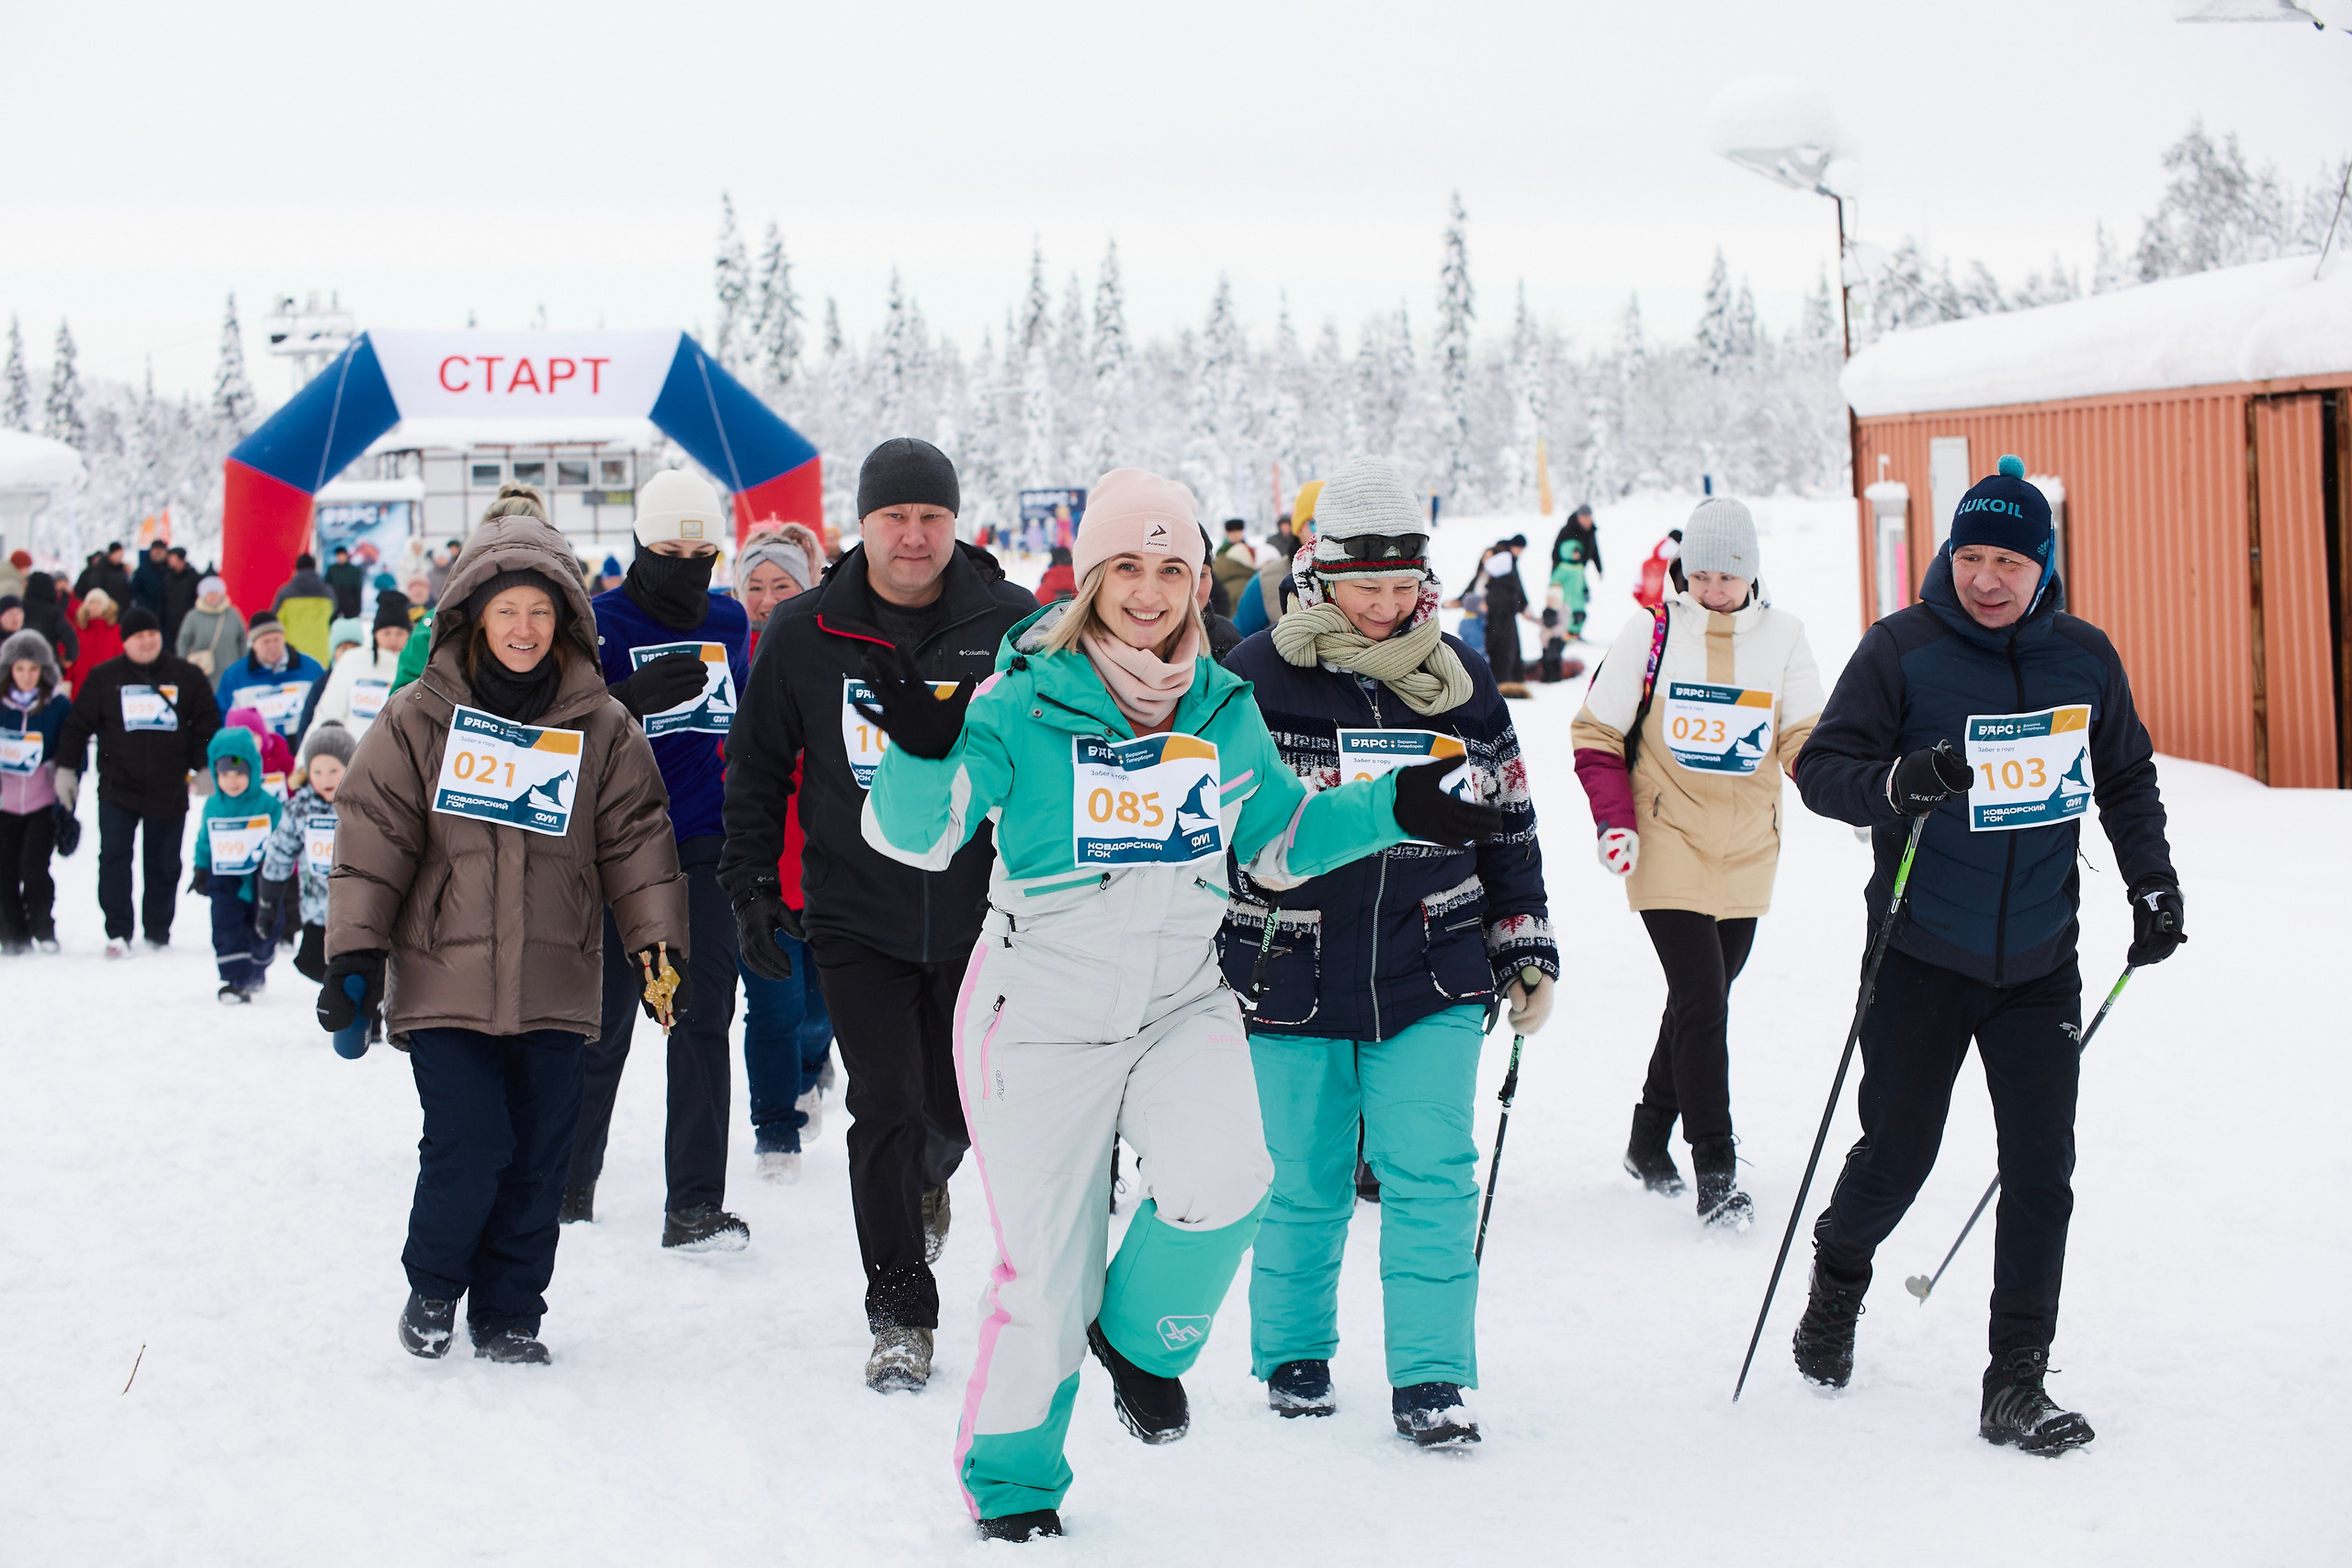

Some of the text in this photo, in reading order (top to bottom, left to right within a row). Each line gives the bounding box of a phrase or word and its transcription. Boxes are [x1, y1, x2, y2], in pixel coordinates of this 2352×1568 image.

[438, 355, 610, 395] СТАРТ
[1958, 498, 2023, 519] LUKOIL
[856, 725, 886, 752] 10
[1672, 716, 1725, 743] 023
[454, 751, 515, 787] 021
[1980, 757, 2047, 791] 103
[446, 800, 465, 808] ГОК
[447, 794, 509, 810] КОВДОРСКИЙ
[1088, 787, 1164, 827] 085
[1983, 803, 2046, 818] КОВДОРСКИЙ
[1088, 841, 1162, 852] КОВДОРСКИЙ
